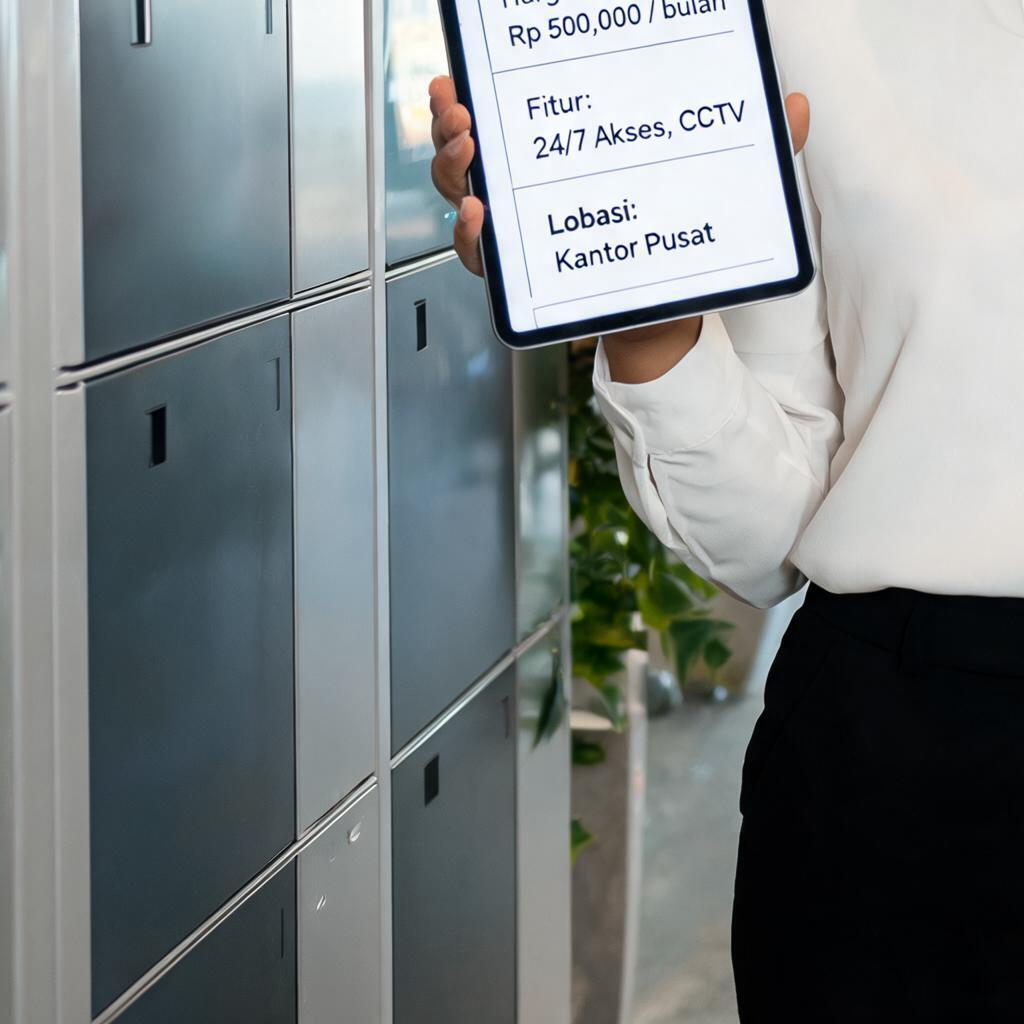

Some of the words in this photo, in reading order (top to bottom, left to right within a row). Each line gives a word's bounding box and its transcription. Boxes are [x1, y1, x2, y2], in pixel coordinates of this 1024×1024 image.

[508, 24, 542, 50] Rp
[548, 3, 642, 40] 500,000
[526, 94, 592, 121] Fitur:
[533, 128, 586, 160] 24/7
[594, 121, 673, 149] Akses,
[679, 99, 745, 132] CCTV
[547, 198, 638, 236] Lobasi:
[555, 240, 638, 273] Kantor
[644, 222, 716, 256] Pusat
